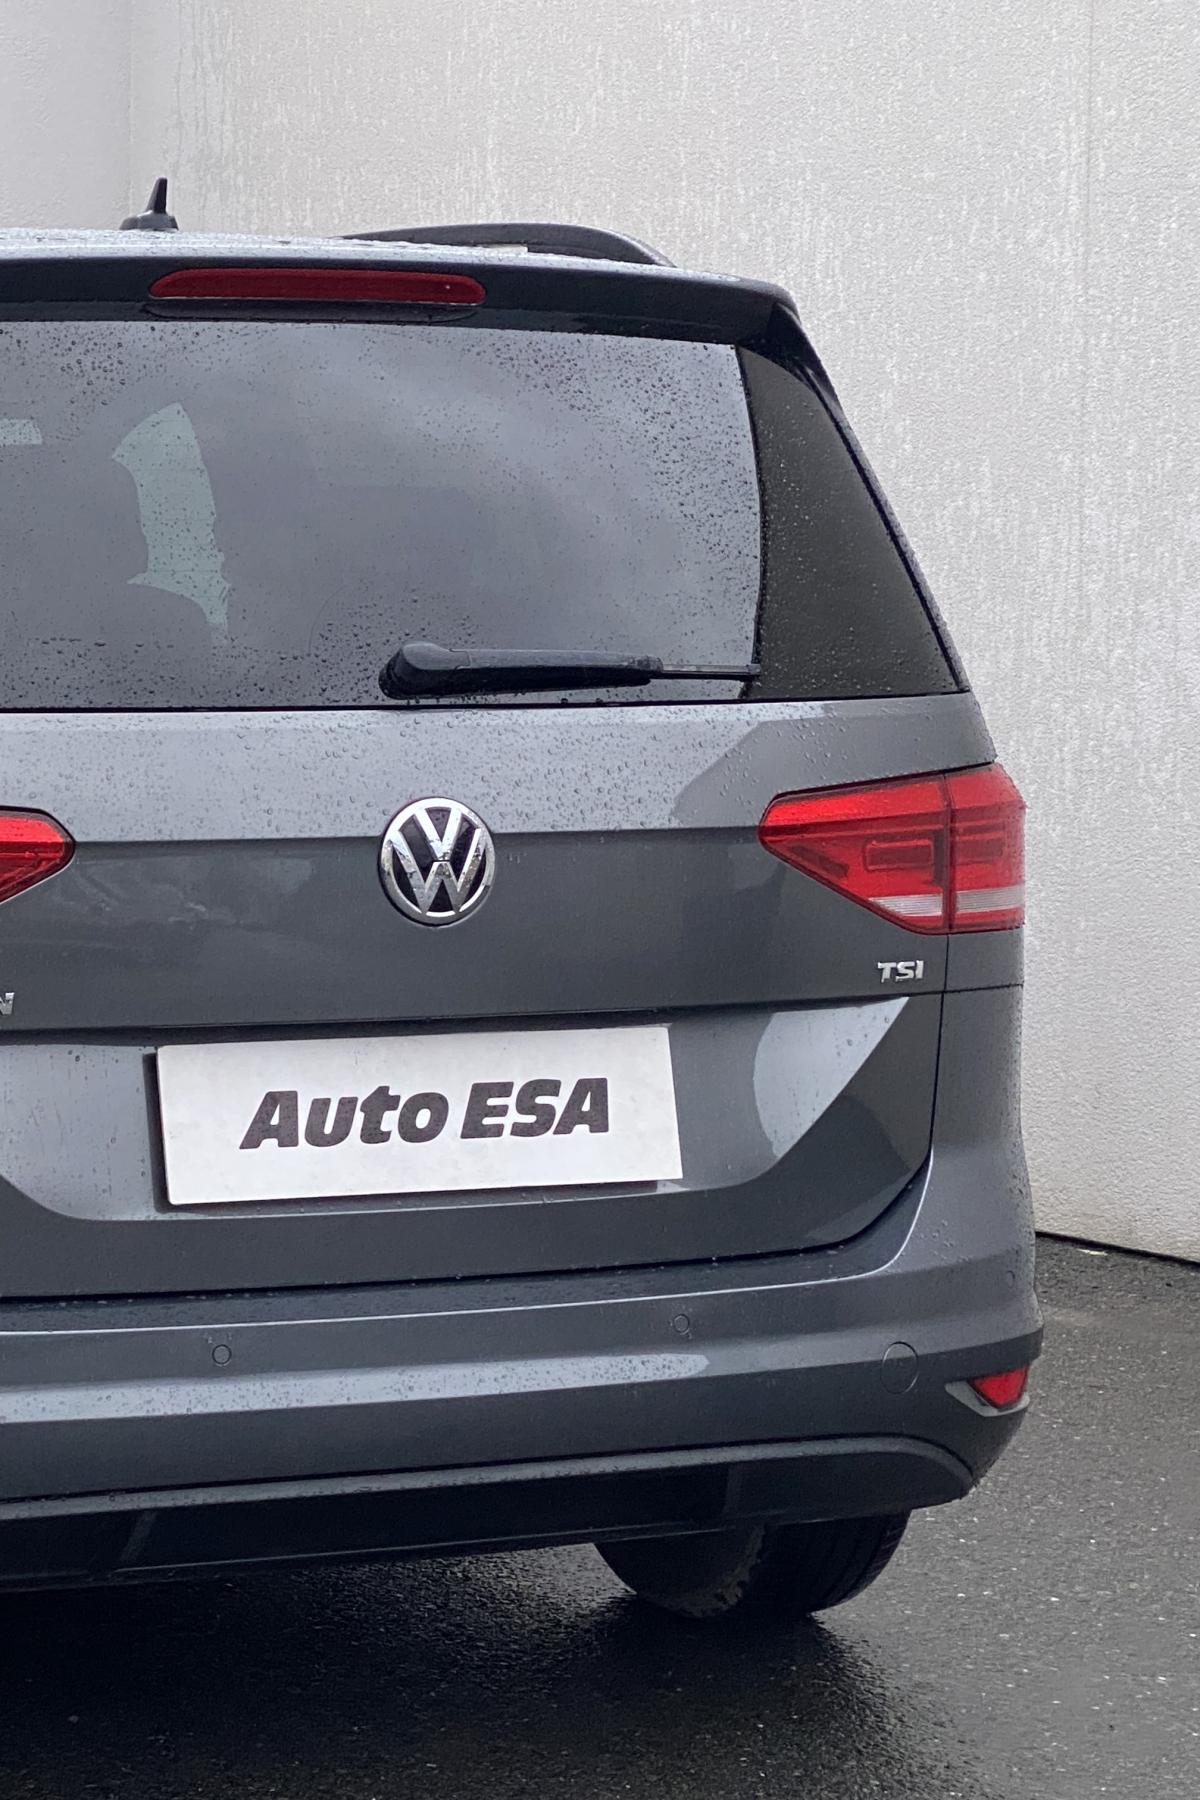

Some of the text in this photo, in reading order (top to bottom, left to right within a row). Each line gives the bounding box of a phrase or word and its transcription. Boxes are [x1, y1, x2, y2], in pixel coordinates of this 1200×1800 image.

[384, 799, 493, 922] VW
[877, 960, 924, 983] TSI
[239, 1077, 609, 1150] Auto ESA
